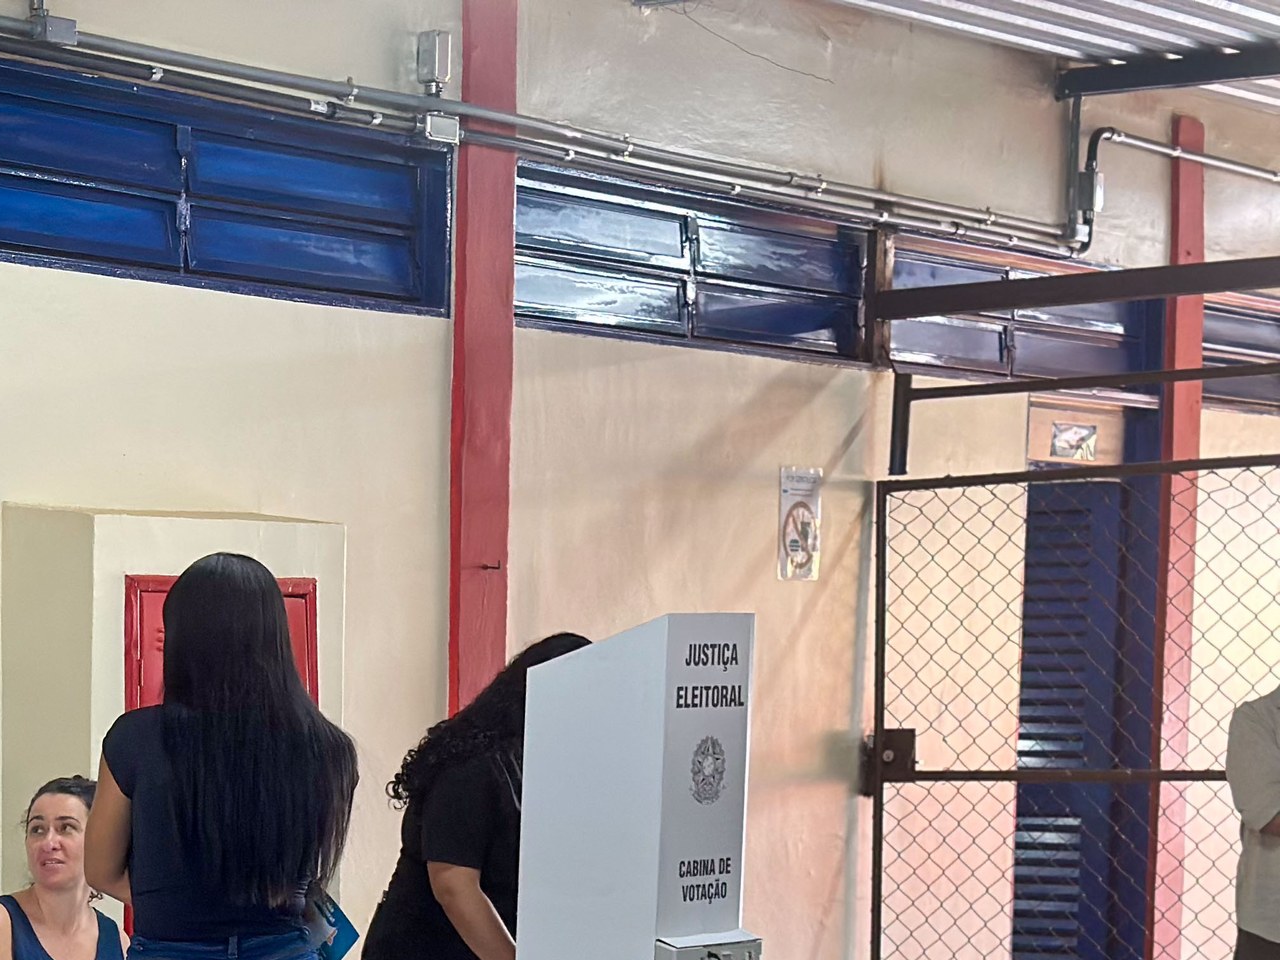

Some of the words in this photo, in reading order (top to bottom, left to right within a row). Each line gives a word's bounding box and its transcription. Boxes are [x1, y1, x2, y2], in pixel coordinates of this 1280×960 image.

[685, 643, 739, 672] JUSTIÇA
[676, 685, 745, 709] ELEITORAL
[678, 859, 716, 878] CABINA
[718, 857, 731, 875] DE
[681, 879, 727, 904] VOTAÇÃO
